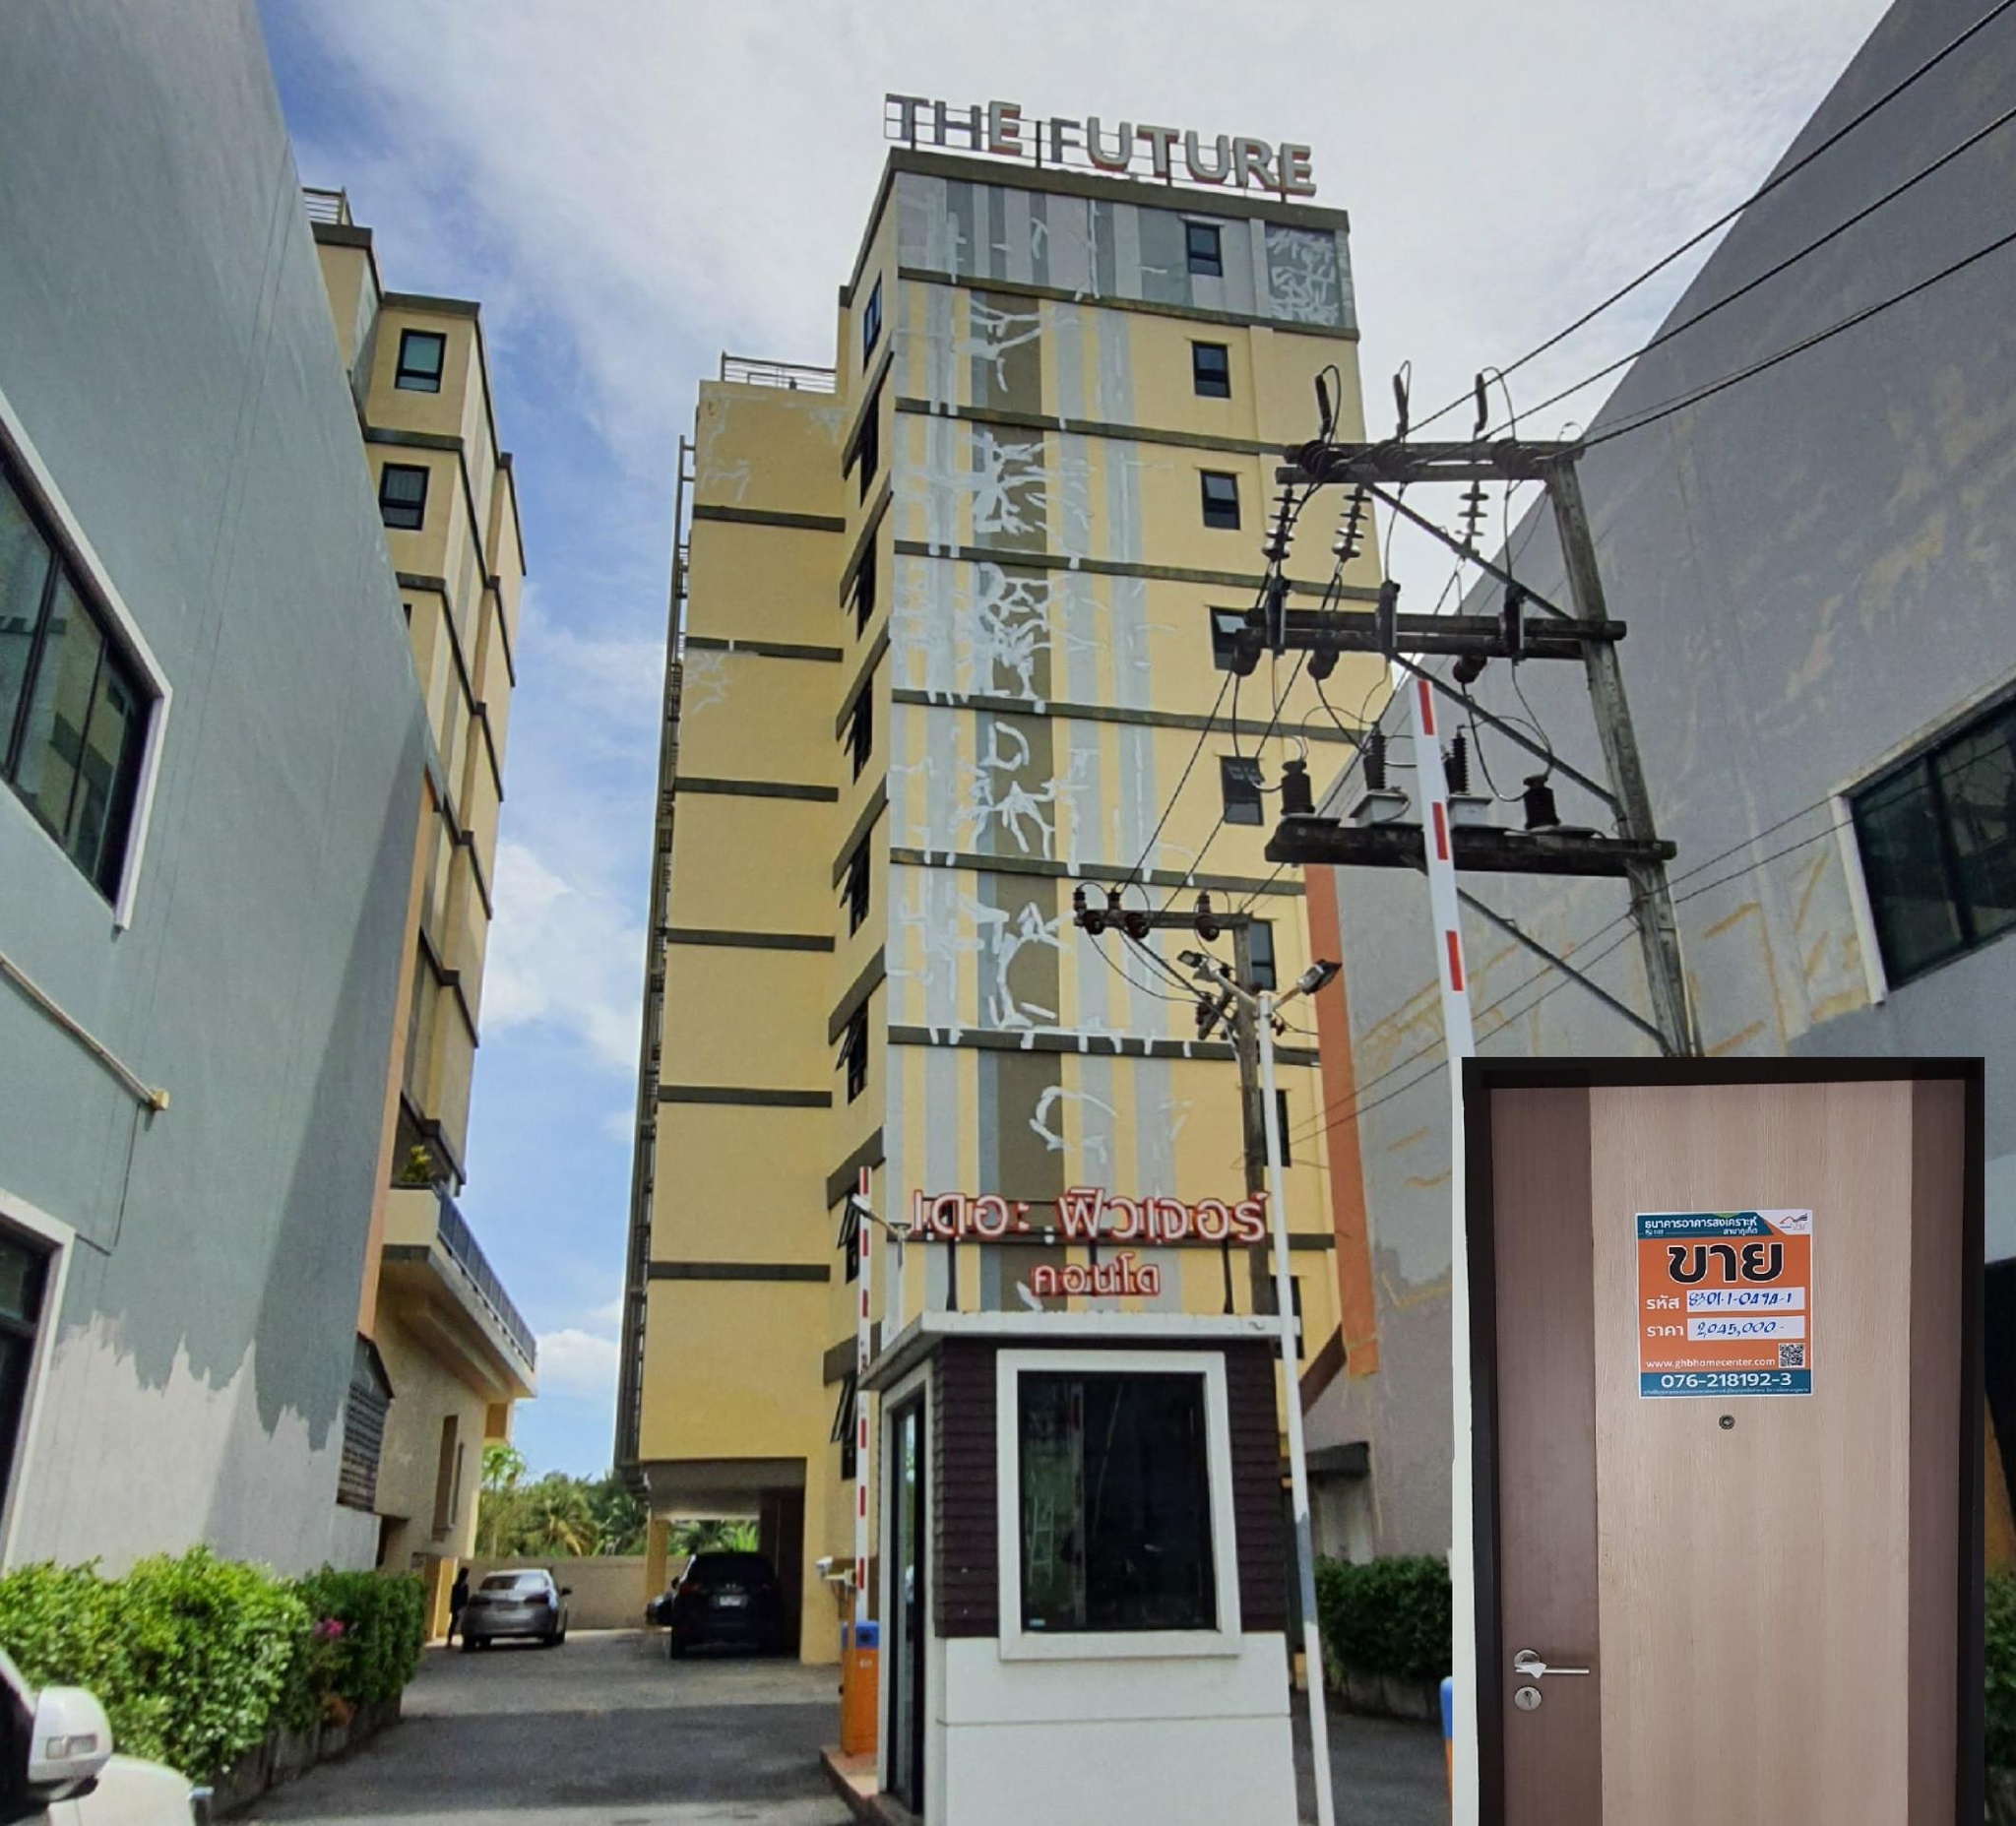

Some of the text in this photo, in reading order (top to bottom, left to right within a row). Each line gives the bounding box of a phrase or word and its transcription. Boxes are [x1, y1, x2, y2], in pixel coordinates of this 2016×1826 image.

[885, 93, 1317, 198] THE FUTURE
[913, 1185, 1271, 1242] เดอะ ฟิวเจอร์
[1645, 1216, 1757, 1229] ธนาคารอาคารสงเคราะห์
[1667, 1241, 1786, 1285] ขาย
[1033, 1251, 1161, 1294] คอนโด
[1646, 1294, 1680, 1310] รหัส
[1647, 1325, 1683, 1338] ราคา
[1646, 1358, 1776, 1369] www.ghbhomecenter.com
[1661, 1372, 1792, 1389] 076-218192-3
